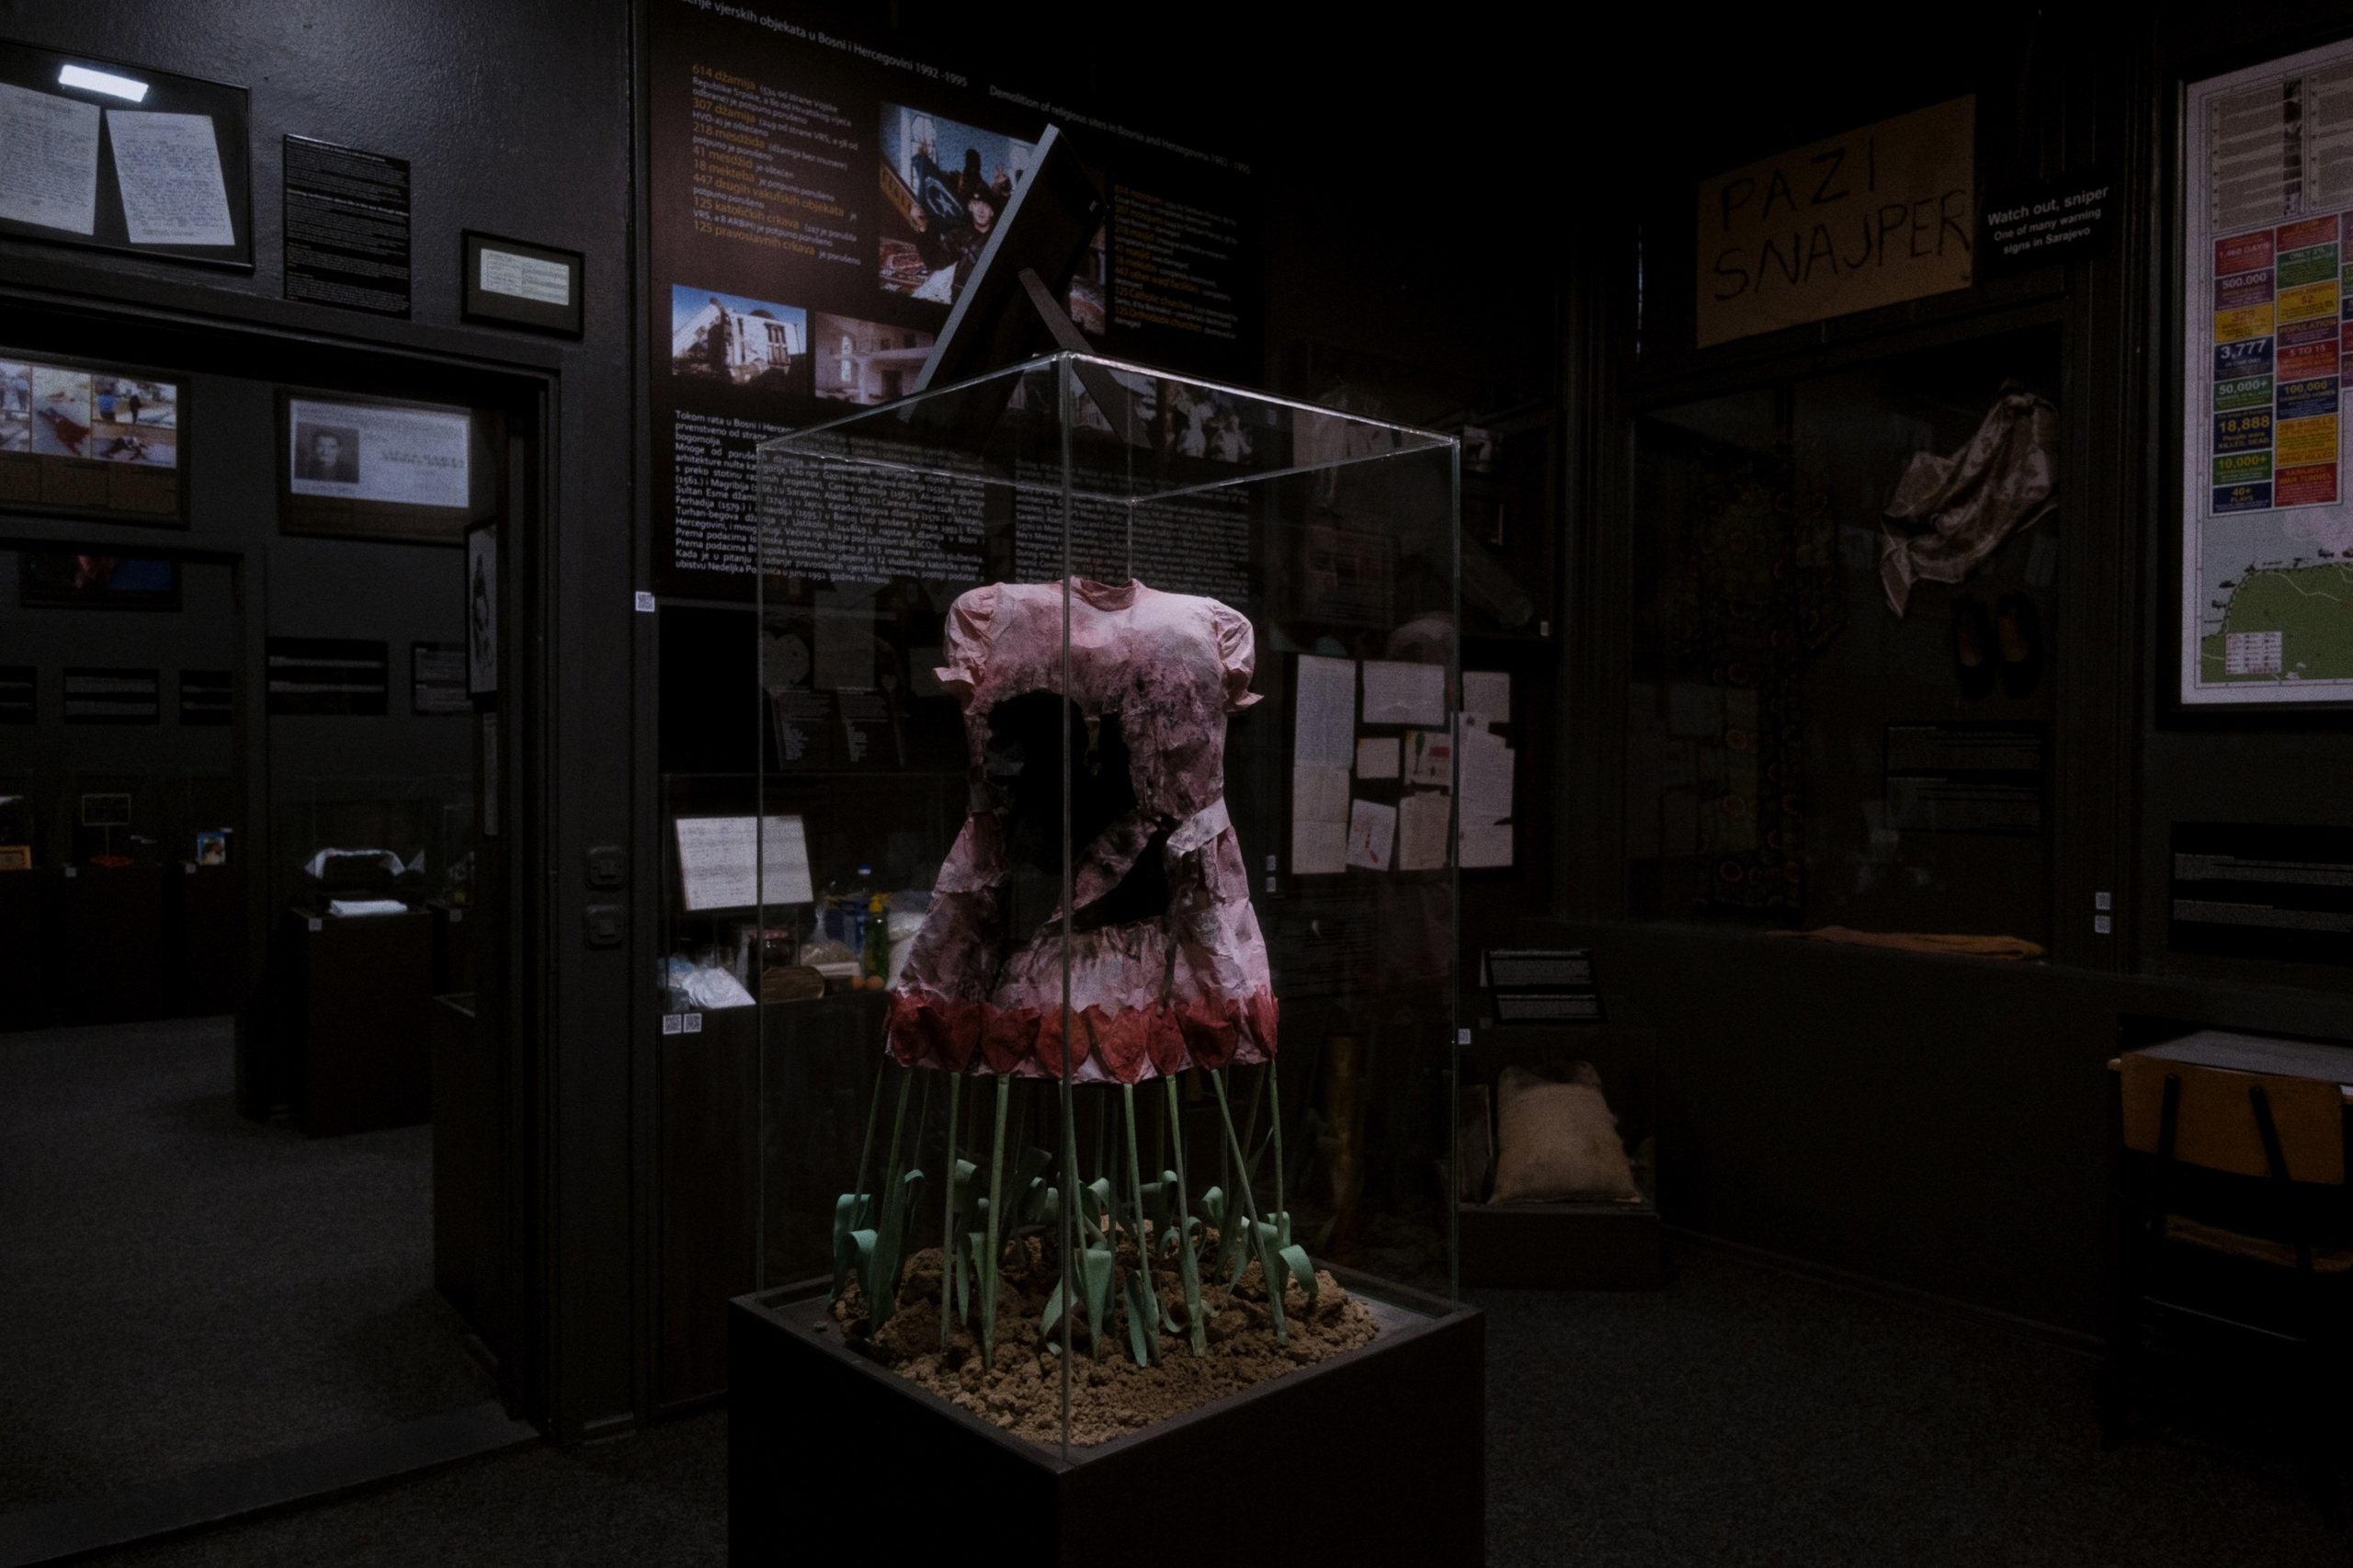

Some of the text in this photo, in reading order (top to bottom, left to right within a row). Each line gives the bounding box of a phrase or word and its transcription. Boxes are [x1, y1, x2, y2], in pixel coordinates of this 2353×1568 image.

[714, 1, 758, 24] vjerskih
[759, 15, 807, 39] objekata
[808, 31, 817, 41] u
[817, 31, 847, 51] Bosni
[853, 42, 914, 72] Hercegovini
[915, 62, 939, 80] 1992
[692, 63, 712, 78] 614
[714, 69, 756, 90] džamija
[693, 97, 713, 111] 307
[714, 103, 756, 124] džamija
[693, 122, 713, 136] 218
[715, 128, 766, 148] mesdžida
[693, 145, 706, 158] 41
[708, 151, 754, 169] mesdžid
[694, 158, 707, 172] 18
[708, 164, 756, 184] mekteba
[693, 172, 713, 186] 447
[714, 178, 750, 197] drugih
[801, 196, 846, 218] objekata
[1721, 137, 1875, 232] PAZI
[694, 196, 713, 210] 125
[767, 212, 800, 231] crkava
[1987, 186, 2109, 227] Watch out, sniper
[1994, 208, 2102, 242] One of many warning
[694, 221, 713, 234] 125
[715, 225, 782, 249] pravoslavnih
[783, 239, 816, 256] crkava
[1714, 188, 1970, 300] SNAJPER
[2003, 226, 2091, 256] signs in Sarajevo
[2222, 272, 2268, 290] 500.000
[2220, 339, 2267, 360] 3,777
[2218, 380, 2268, 397] 50,000+
[675, 409, 756, 430] Tokom rata u Bosni
[2218, 415, 2270, 435] 18,888
[675, 423, 768, 441] prvenstveno od strane
[675, 442, 706, 457] Mnoge
[710, 447, 723, 457] od
[675, 453, 745, 471] arhitekture nulte
[2218, 455, 2268, 471] 10,000+
[684, 466, 743, 481] preko stotinu
[675, 485, 730, 500] Sultan Esme
[710, 478, 750, 493] Magribija
[675, 494, 716, 509] Ferhadija
[675, 506, 739, 522] Turhan-begova
[675, 517, 727, 532] Hercegovini,
[675, 527, 704, 539] Prema
[705, 530, 748, 543] podacima
[675, 538, 704, 550] Prema
[705, 541, 746, 553] podacima
[675, 548, 699, 560] Kada
[701, 551, 710, 562] je
[712, 553, 720, 562] u
[722, 553, 753, 565] pitanju
[675, 558, 707, 570] ubistvu
[707, 562, 745, 574] Nedeljka
[789, 569, 807, 580] junu
[830, 573, 856, 585] godine
